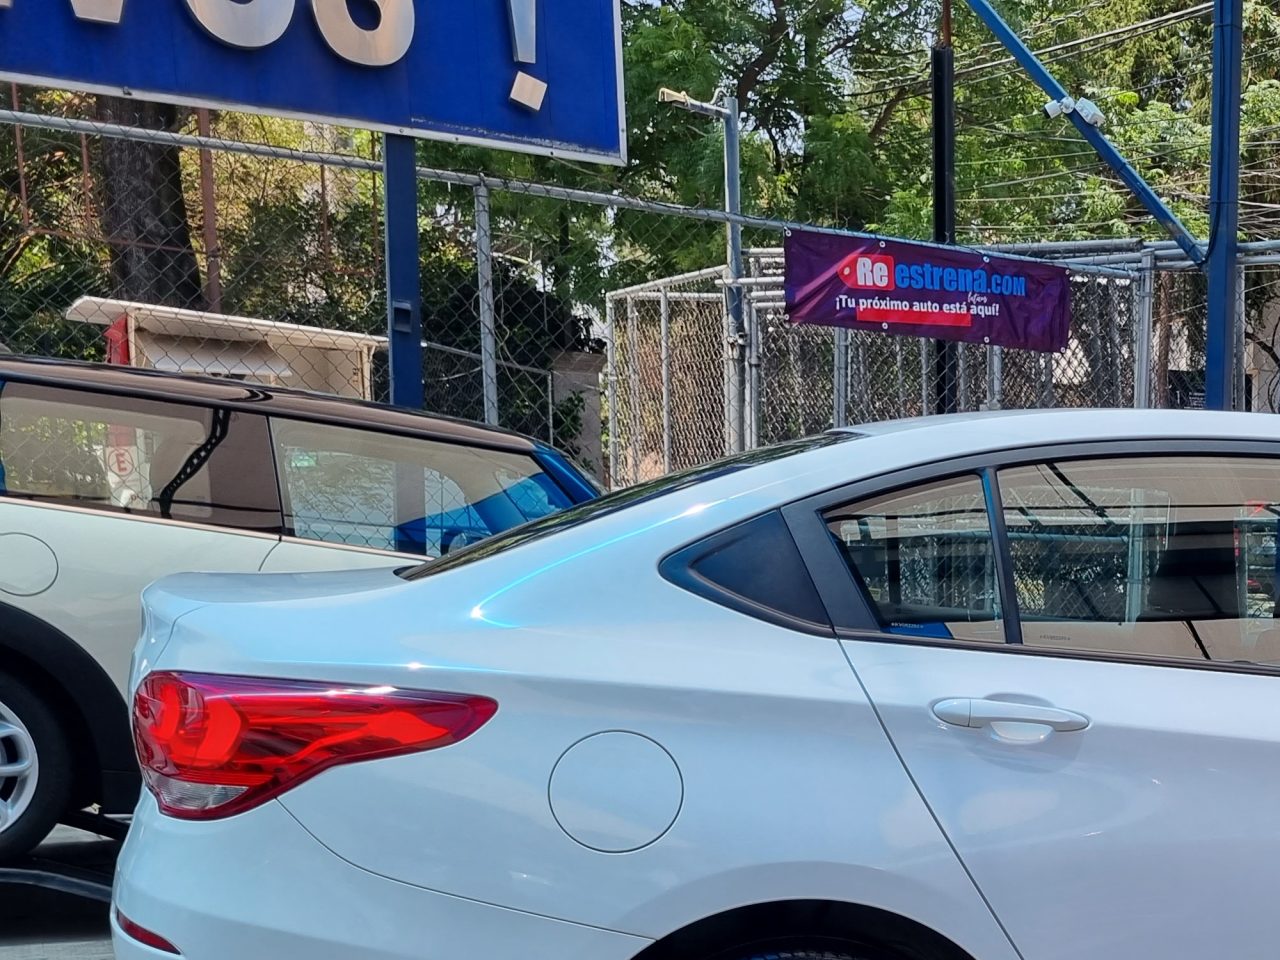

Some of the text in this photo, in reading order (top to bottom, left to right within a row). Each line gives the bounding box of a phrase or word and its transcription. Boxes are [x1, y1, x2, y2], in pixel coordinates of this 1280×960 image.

[835, 295, 1000, 318] ¡Tu próximo auto está aquí!
